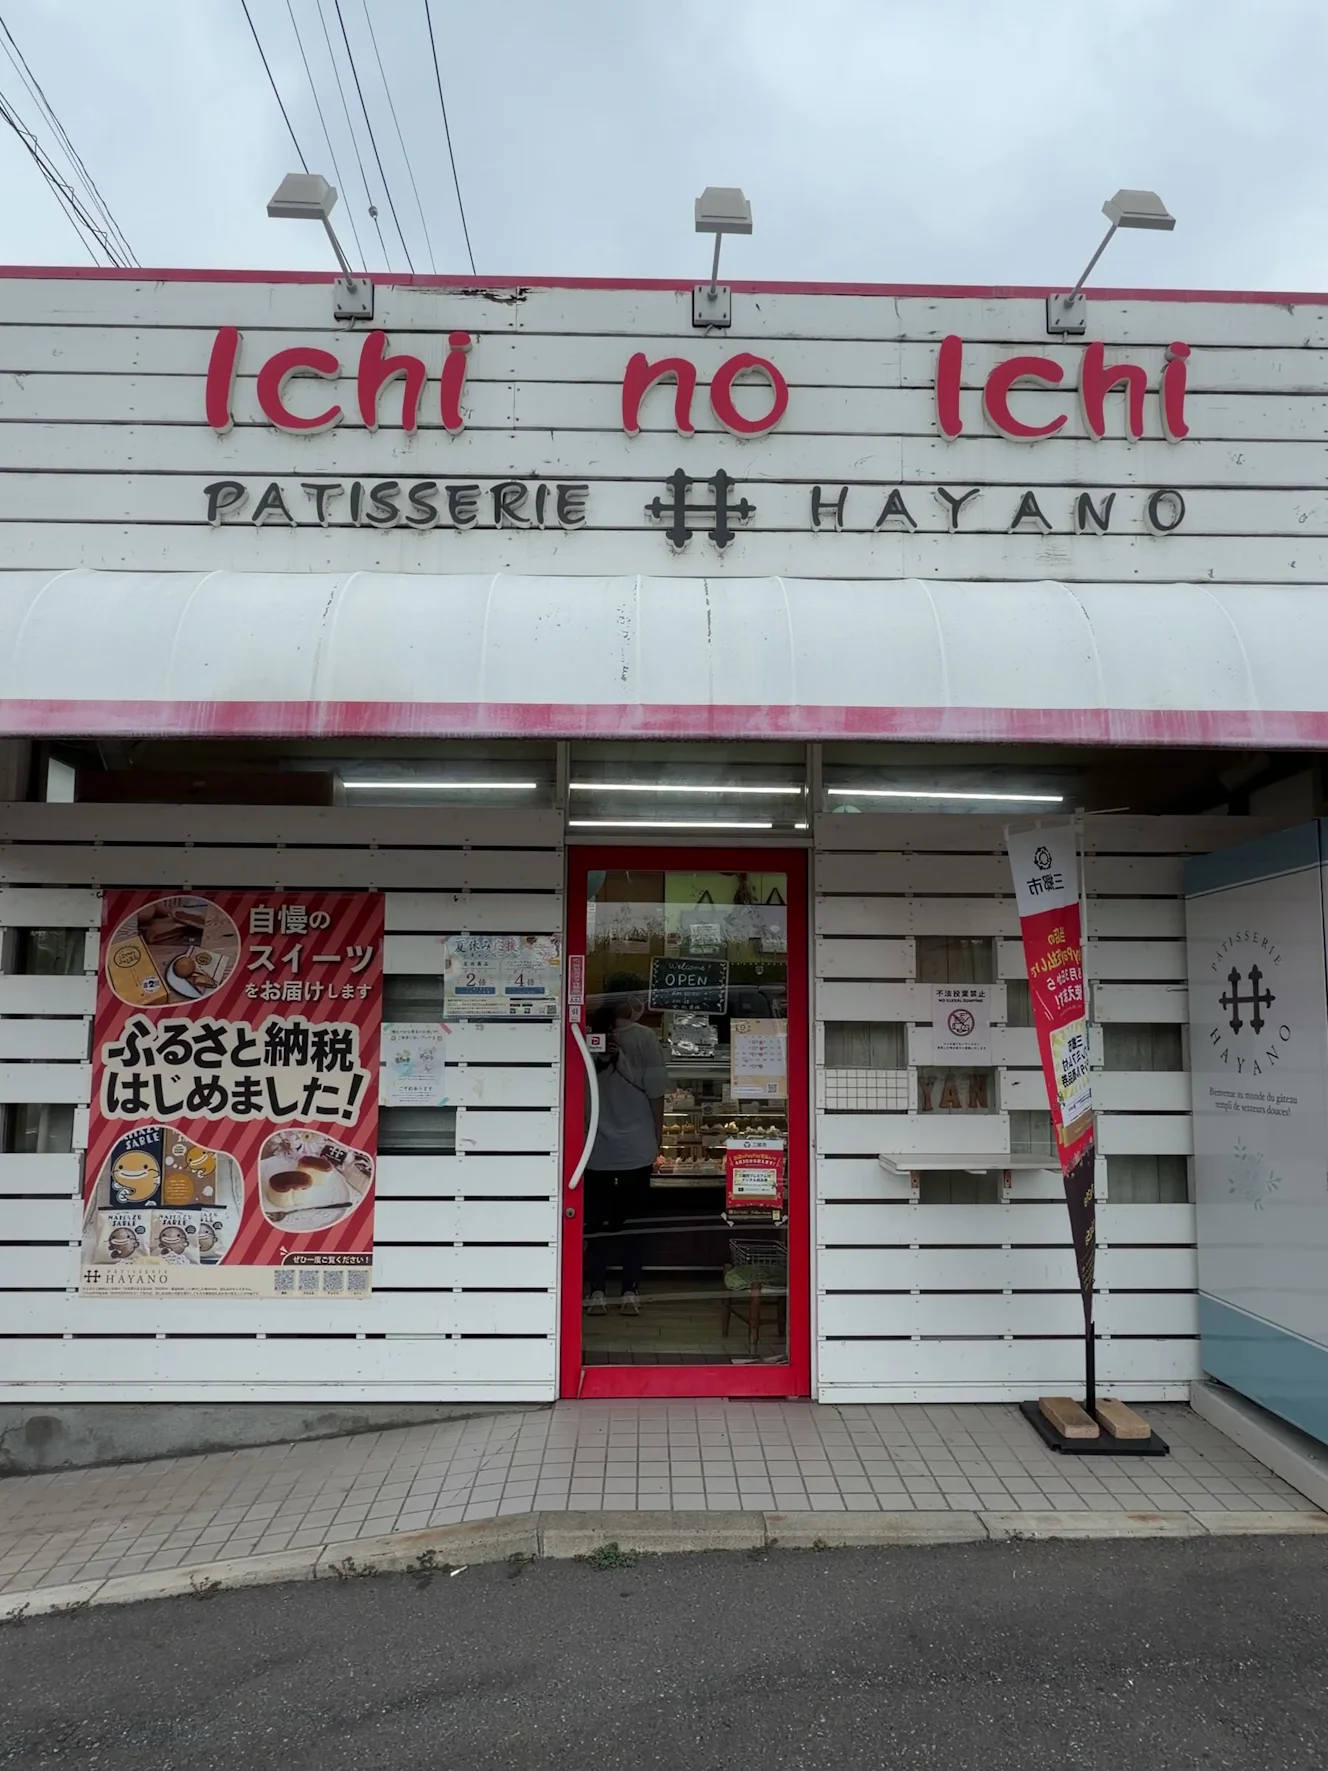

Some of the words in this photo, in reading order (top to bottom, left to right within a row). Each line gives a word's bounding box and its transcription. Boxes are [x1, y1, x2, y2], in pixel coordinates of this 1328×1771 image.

[205, 326, 472, 436] Ichi
[621, 352, 790, 439] no
[933, 335, 1192, 443] Ichi
[203, 481, 590, 530] PATISSERIE
[810, 486, 1186, 536] HAYANO
[249, 904, 331, 935] 自慢の
[246, 945, 374, 974] スイーツ
[244, 980, 372, 1001] をお届けします
[665, 973, 708, 986] OPEN
[108, 1020, 354, 1072] ふるさと納税
[1210, 1024, 1291, 1077] HAYANO
[1233, 1101, 1240, 1111] de
[1267, 1092, 1275, 1102] du
[106, 1274, 168, 1284] HAYANO
